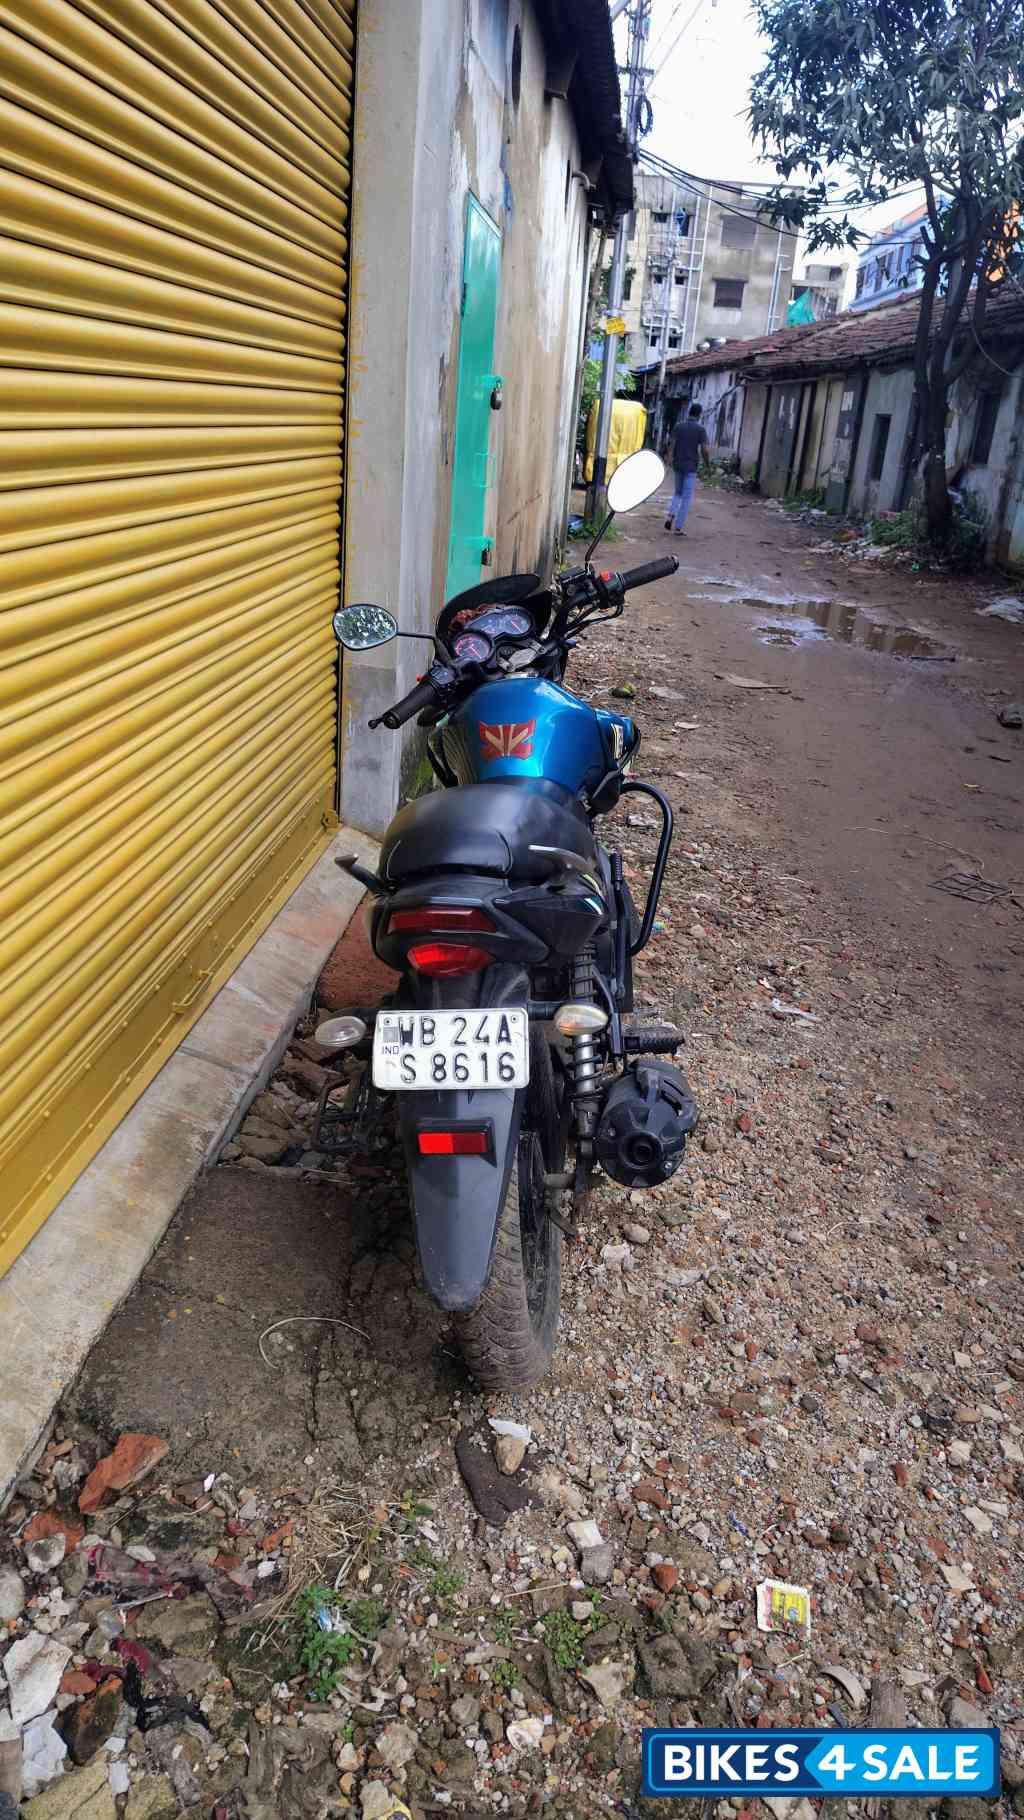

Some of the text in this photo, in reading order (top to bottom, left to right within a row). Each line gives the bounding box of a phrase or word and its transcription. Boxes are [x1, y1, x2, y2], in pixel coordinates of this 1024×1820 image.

[399, 1014, 512, 1046] WB 24A
[382, 1045, 399, 1055] IND
[402, 1052, 515, 1084] S 8616
